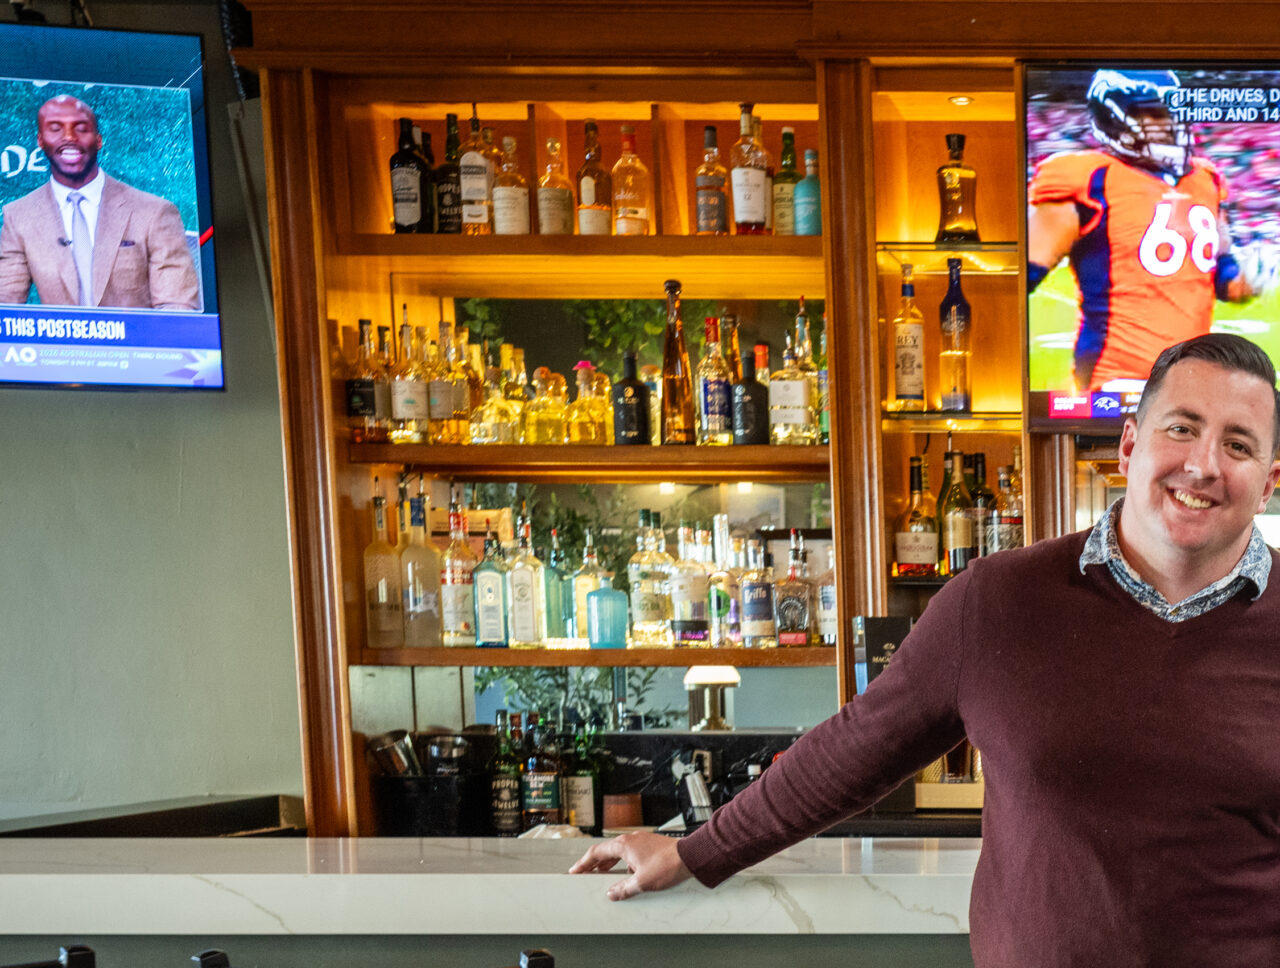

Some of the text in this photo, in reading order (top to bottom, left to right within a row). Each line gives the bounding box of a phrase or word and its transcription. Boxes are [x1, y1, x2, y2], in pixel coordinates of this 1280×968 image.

[1178, 88, 1207, 103] THE
[1210, 88, 1267, 104] DRIVES,
[1178, 107, 1280, 122] THIRD AND 14
[1139, 203, 1219, 277] 68
[3, 317, 125, 340] THIS POSTSEASON
